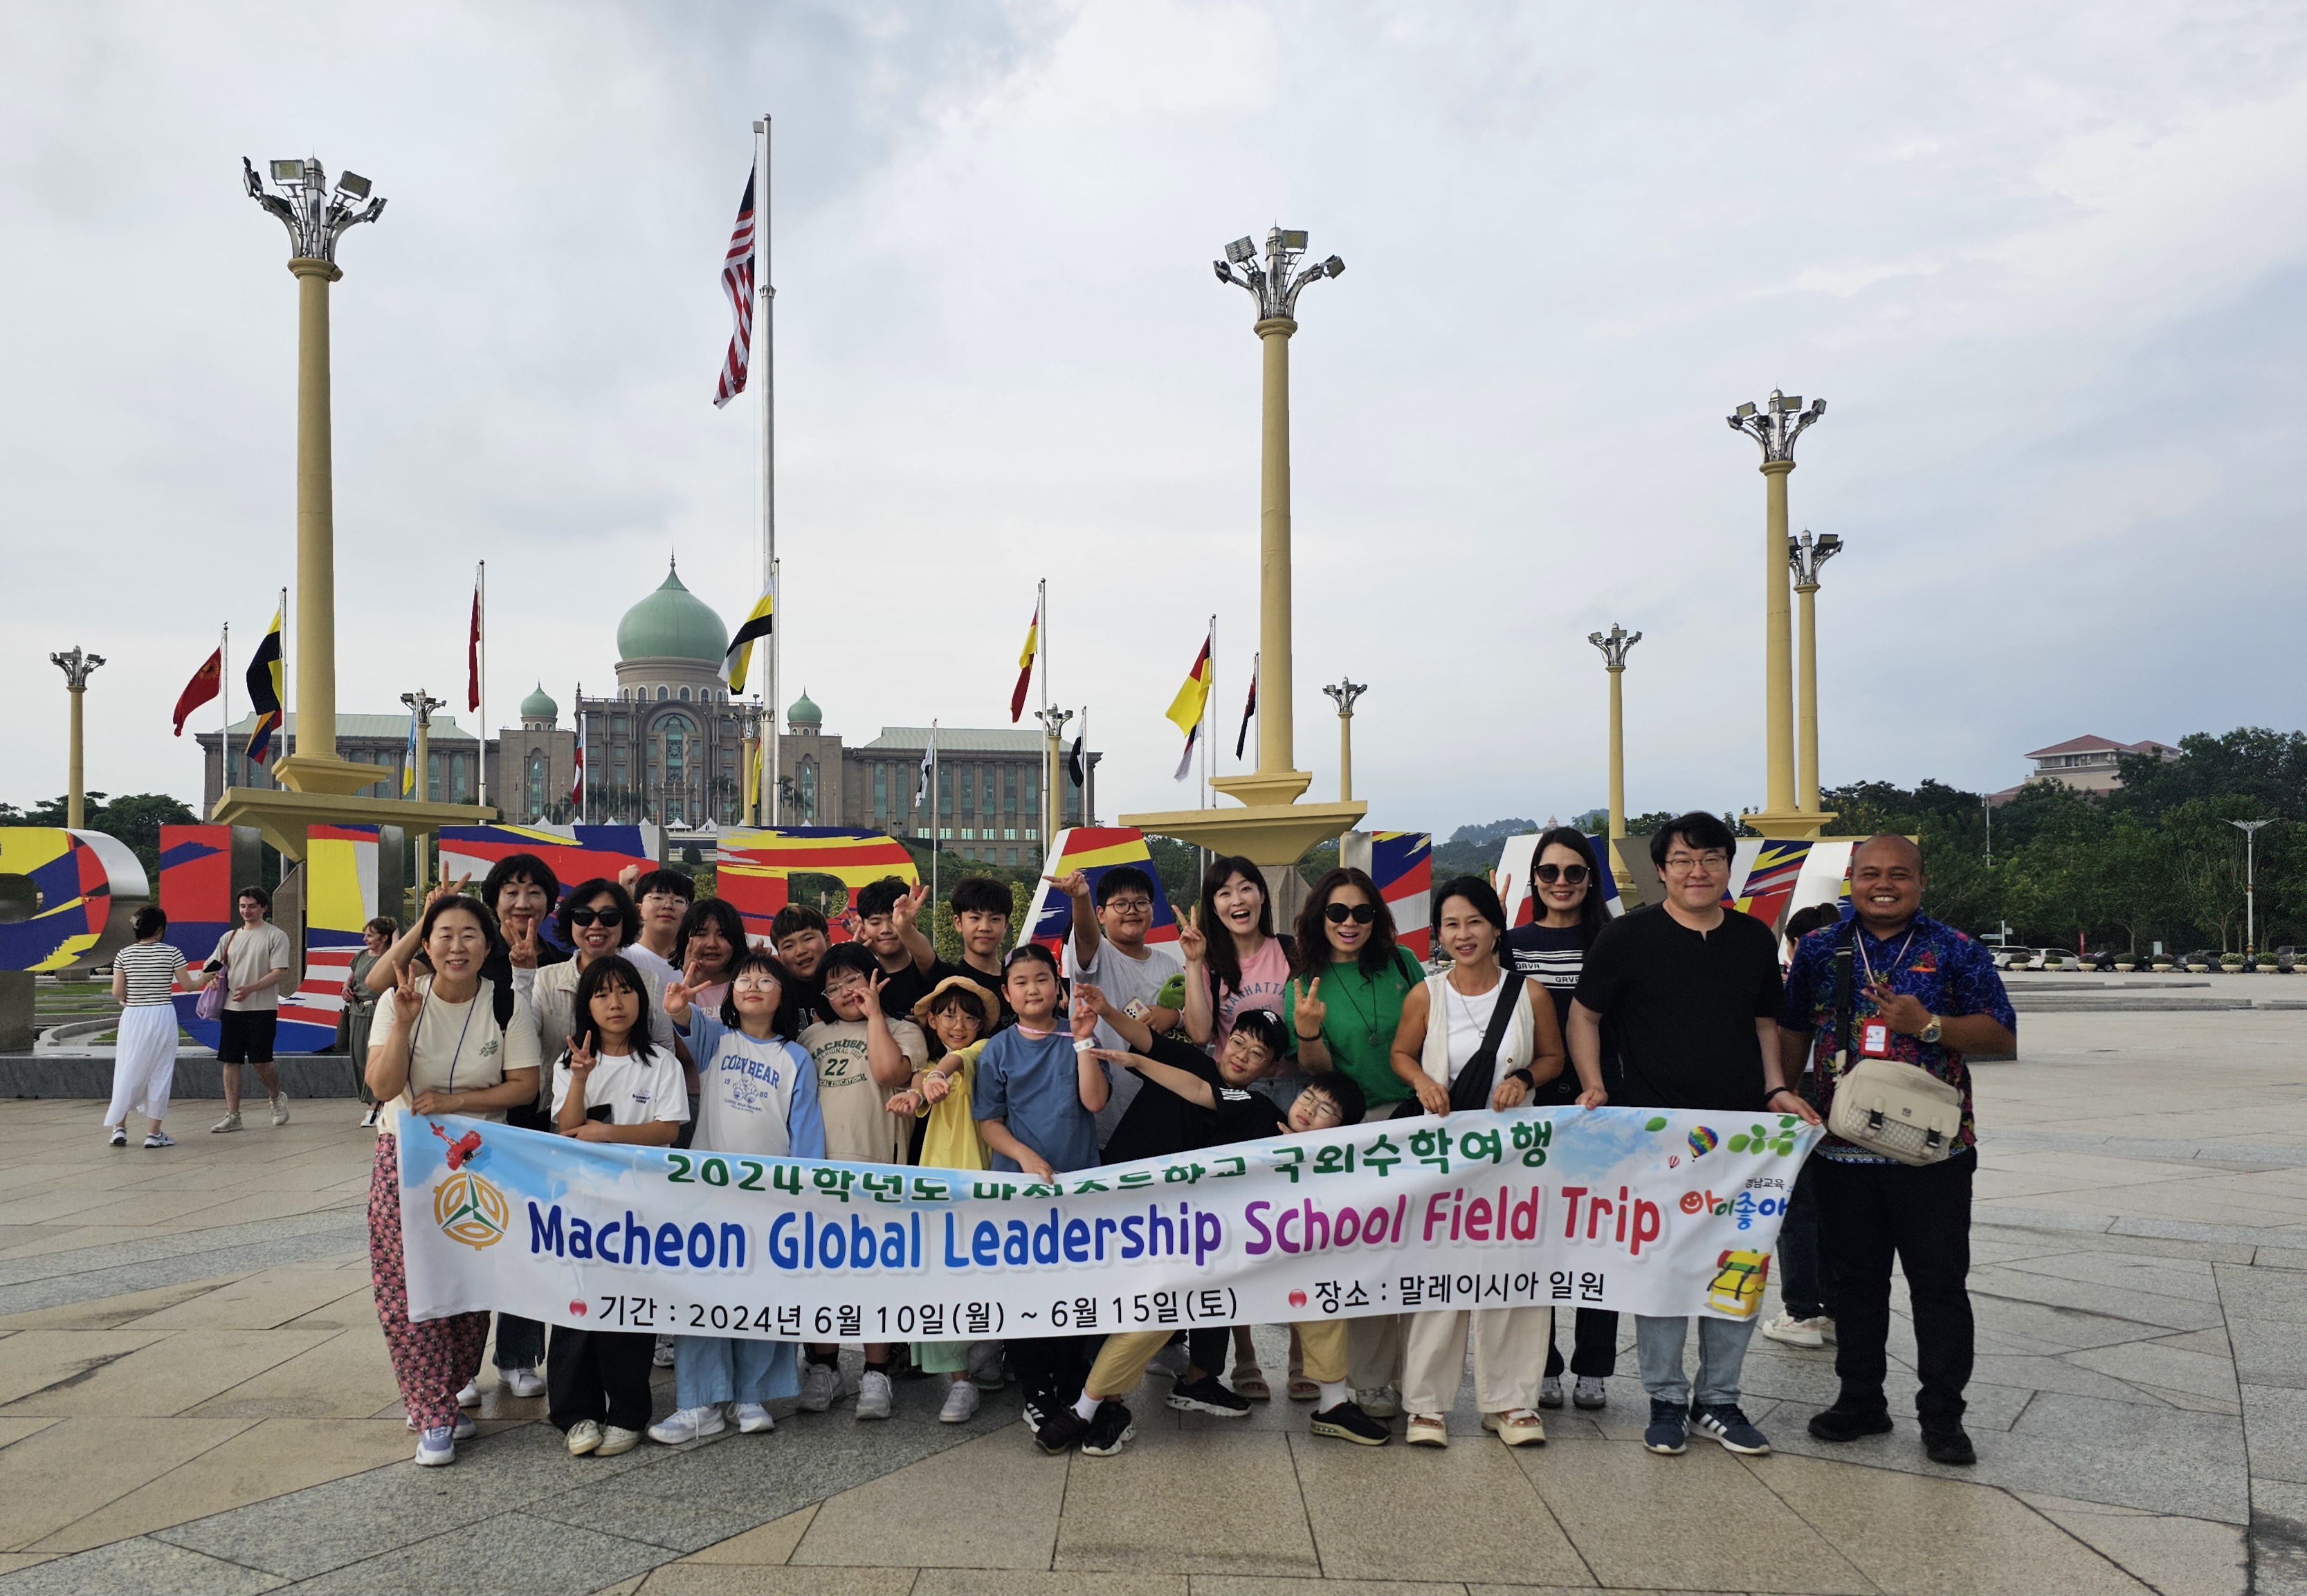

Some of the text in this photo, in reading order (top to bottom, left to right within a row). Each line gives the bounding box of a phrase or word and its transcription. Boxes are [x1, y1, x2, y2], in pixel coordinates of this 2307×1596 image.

[720, 1054, 780, 1090] COZY BEAR
[824, 1058, 849, 1076] 22
[666, 1153, 951, 1204] 2024학년도
[1272, 1120, 1553, 1184] 국외수학여행
[528, 1186, 1660, 1270] Macheon Global Leadership School Field Trip
[1399, 1271, 1540, 1304] 말레이시아
[1549, 1270, 1605, 1303] 일원
[689, 1303, 801, 1337] 2024년
[814, 1305, 861, 1337] 6월
[1050, 1297, 1098, 1328] 6월
